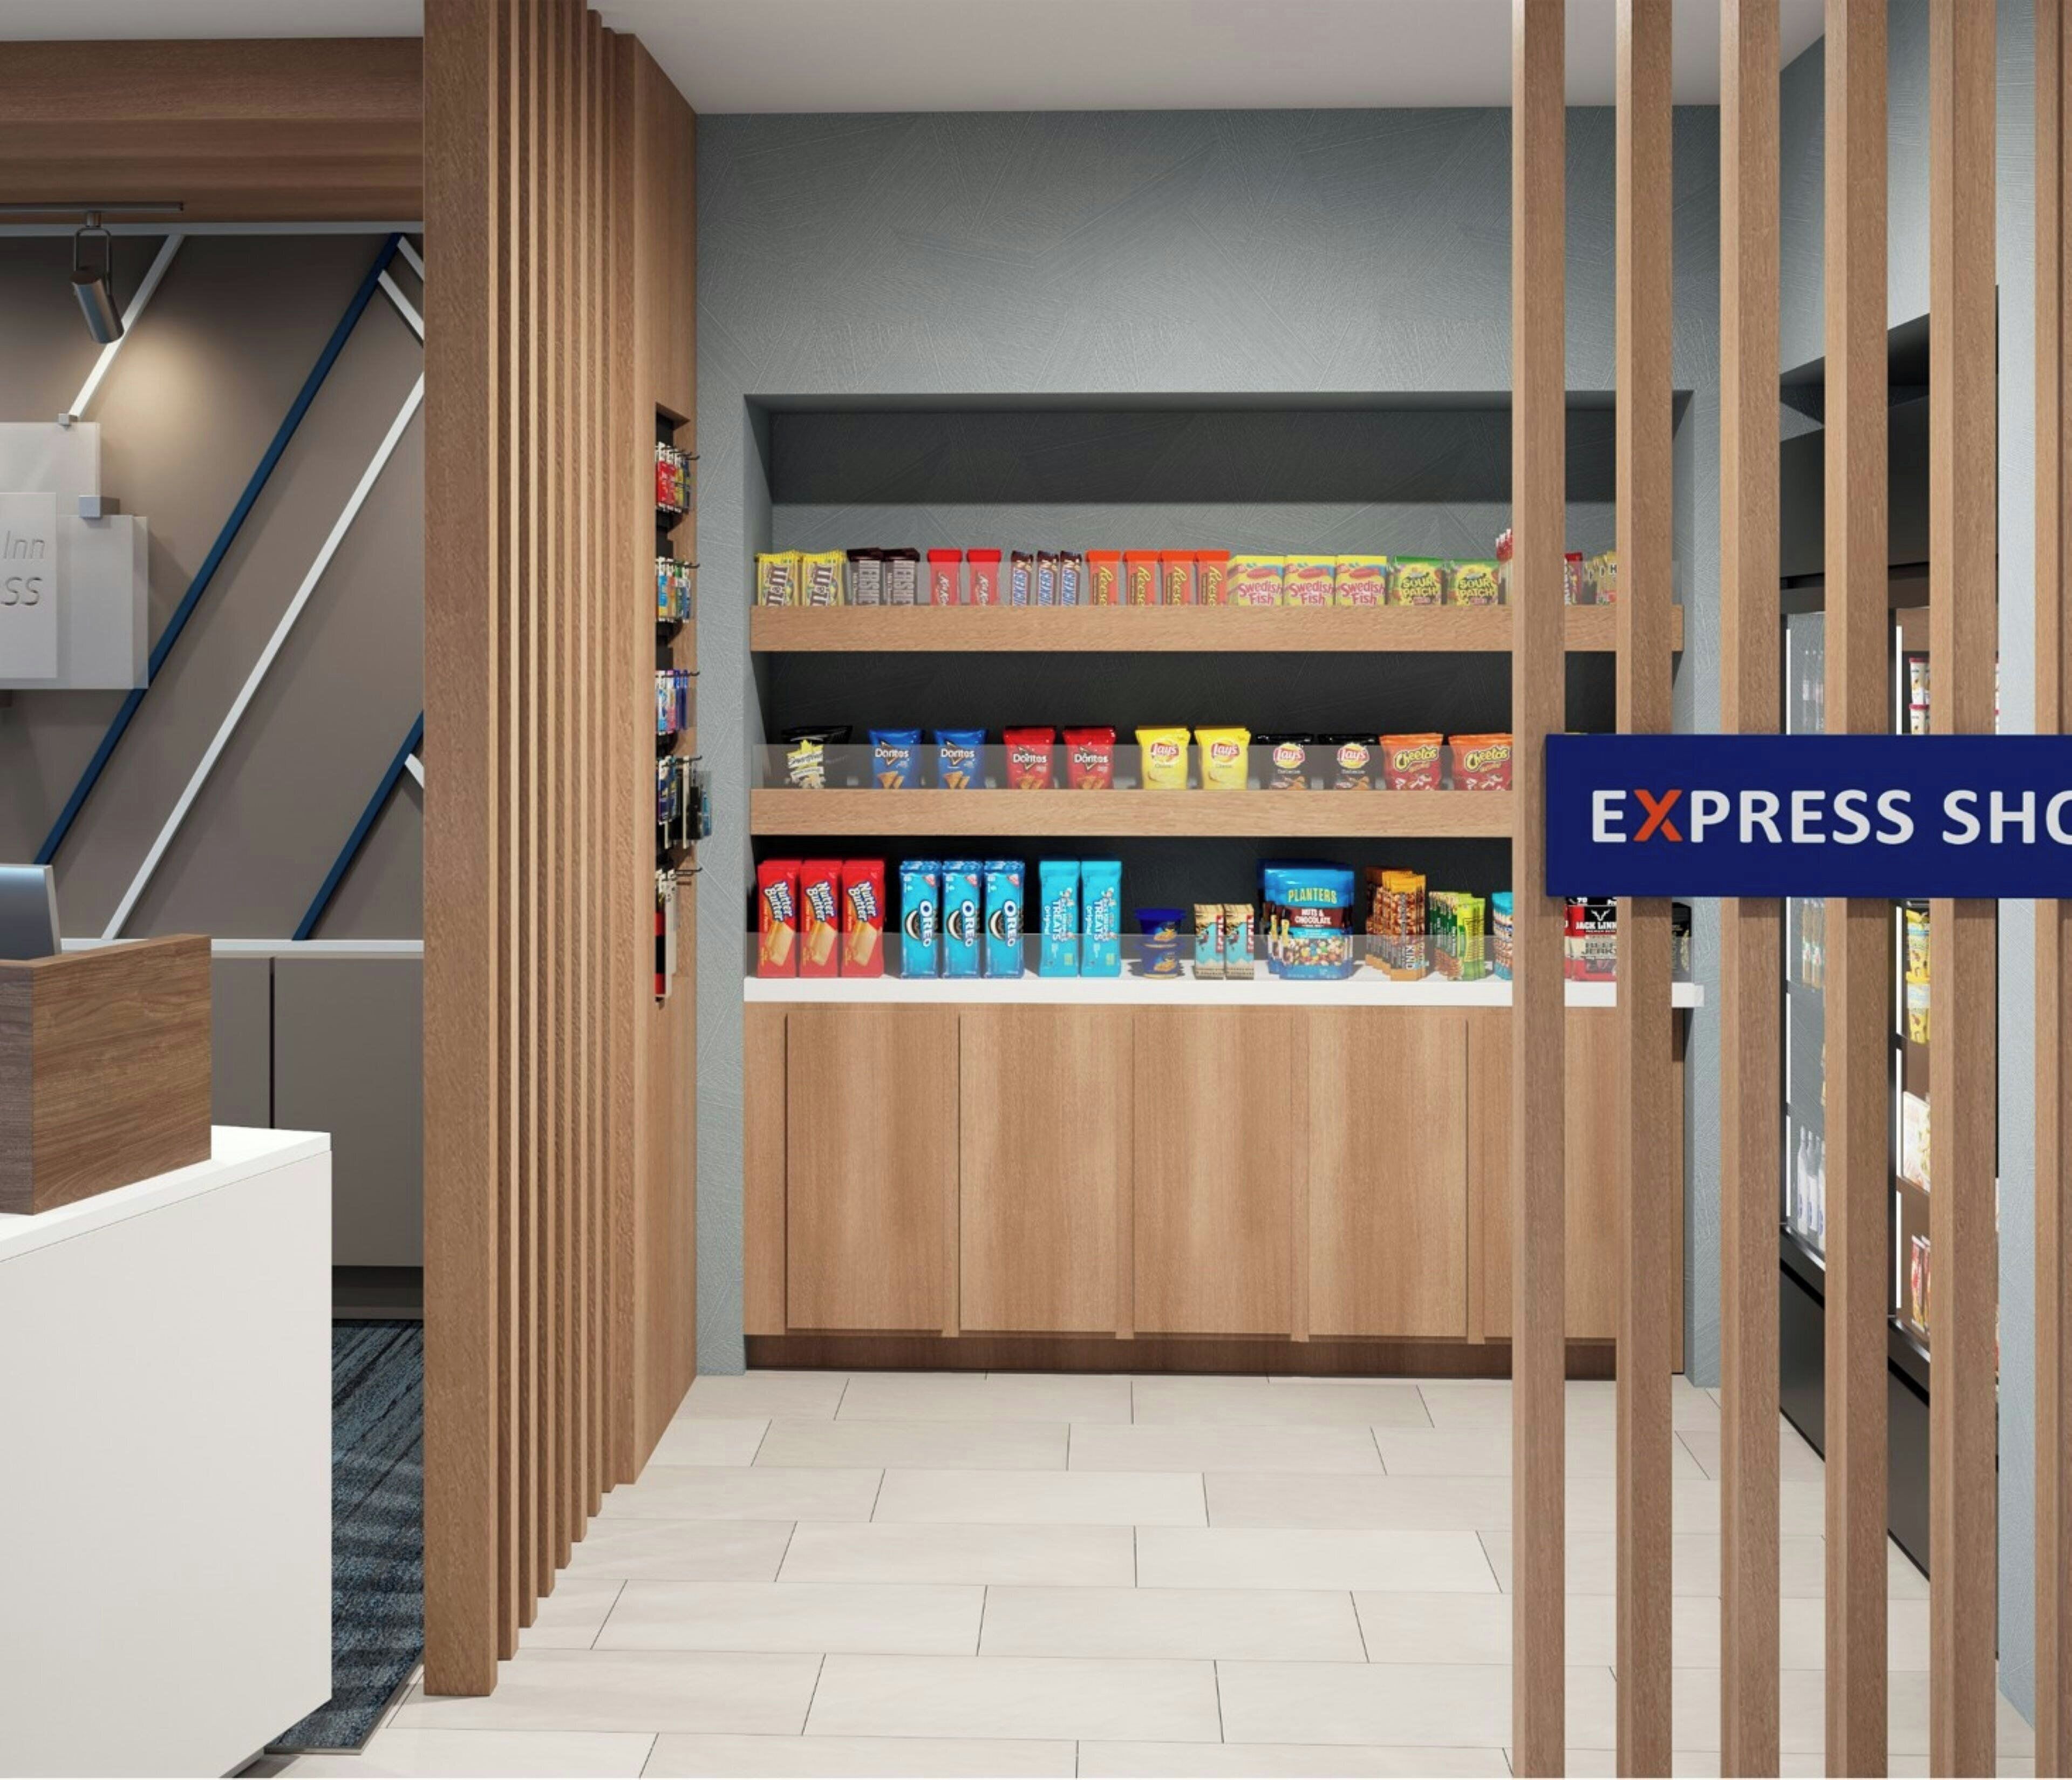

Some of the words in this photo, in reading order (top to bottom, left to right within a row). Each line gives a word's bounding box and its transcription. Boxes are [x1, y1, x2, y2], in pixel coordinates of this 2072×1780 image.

[3, 531, 45, 560] Inn
[1238, 581, 1283, 597] Swedish
[1289, 581, 1334, 597] Swedish
[1340, 581, 1386, 597] Swedish
[1249, 593, 1274, 605] Fish
[1300, 593, 1325, 605] Fish
[1352, 593, 1376, 605] Fish
[875, 748, 909, 757] Doritos
[941, 748, 974, 757] Doritos
[1013, 753, 1047, 763] Doritos
[1074, 753, 1108, 763] Doritos
[1394, 746, 1437, 770] Cheetos
[1466, 746, 1509, 770] Cheetos
[1592, 789, 1914, 845] EXPRESS
[1287, 887, 1337, 904] PLANTERS
[919, 900, 932, 947] OREO
[962, 900, 975, 947] OREO
[1004, 900, 1017, 947] OREO
[1053, 901, 1062, 941] TREATS
[1094, 901, 1103, 941] TREATS
[1294, 916, 1331, 925] CHOCOLATE
[1576, 921, 1596, 930] JACK
